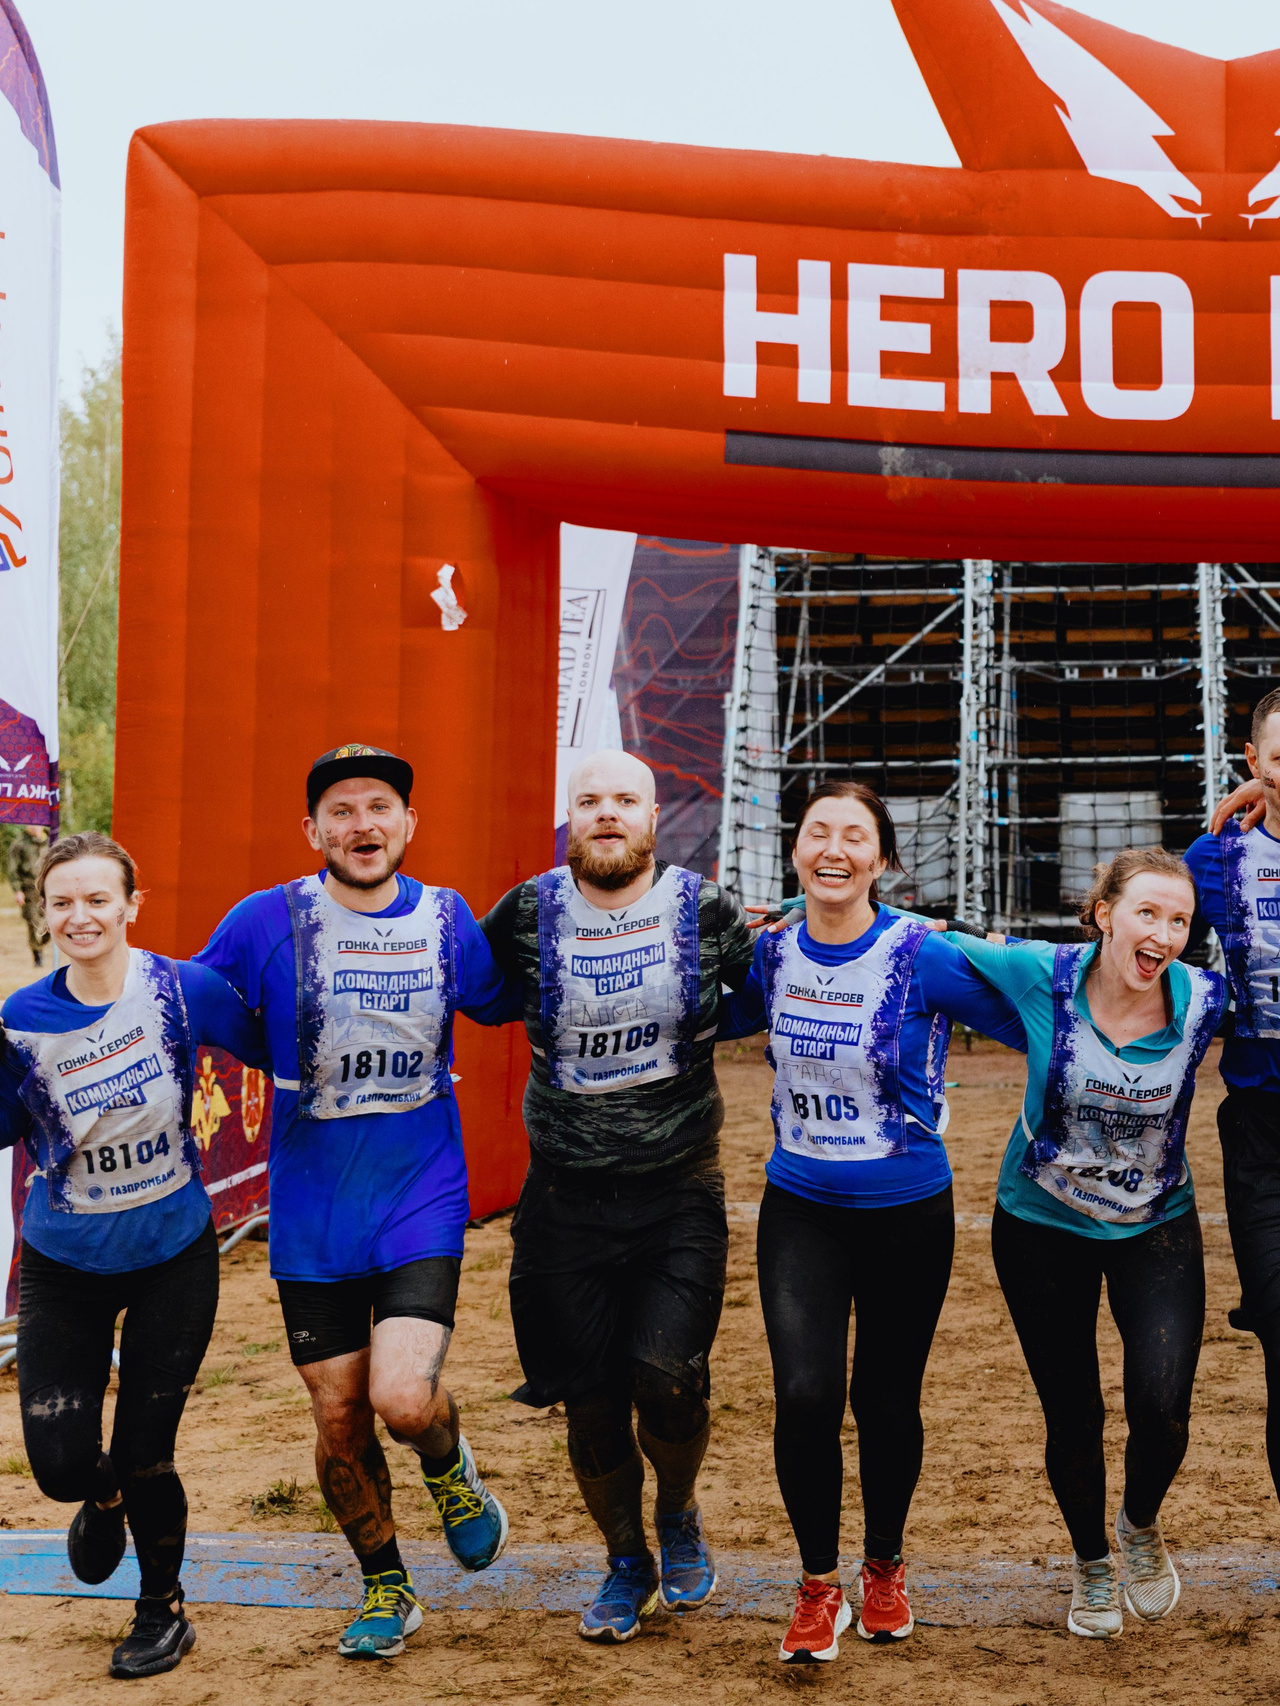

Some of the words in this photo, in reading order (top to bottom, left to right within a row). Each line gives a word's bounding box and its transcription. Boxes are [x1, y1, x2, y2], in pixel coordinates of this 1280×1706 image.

[723, 253, 1195, 421] HERO
[579, 642, 593, 694] LONDON
[575, 926, 613, 938] ГОНКА
[616, 915, 660, 934] ГЕРОЕВ
[337, 940, 379, 951] ГОНКА
[383, 938, 428, 951] ГЕРОЕВ
[572, 941, 665, 976] КОМАНДНЫЙ
[335, 966, 432, 994] КОМАНДНЫЙ
[597, 969, 640, 995] СТАРТ
[785, 983, 818, 1000] ГОНКА
[820, 990, 864, 1004] ГЕРОЕВ
[361, 992, 407, 1011] СТАРТ
[577, 1021, 660, 1059] 18109
[776, 1015, 860, 1043] КОМАНДНЫЙ
[57, 1050, 98, 1073] ГОНКА
[99, 1025, 144, 1056] ГЕРОЕВ
[792, 1038, 833, 1059] СТАРТ
[340, 1049, 424, 1083] 18102
[592, 1058, 659, 1082] ГАЗПРОМБАНК
[782, 1062, 845, 1088] ТАНЯ
[66, 1053, 161, 1112] КОМАНДНЫЙ
[1085, 1078, 1125, 1097] ГОНКА
[1129, 1084, 1172, 1100] ГЕРОЕВ
[99, 1087, 143, 1116] СТАРТ
[355, 1091, 422, 1105] ГАЗПРОМБАНК
[1104, 1126, 1143, 1141] СТАРТ
[82, 1131, 170, 1175] 18104
[109, 1167, 176, 1197] ГАЗПРОМБАНК
